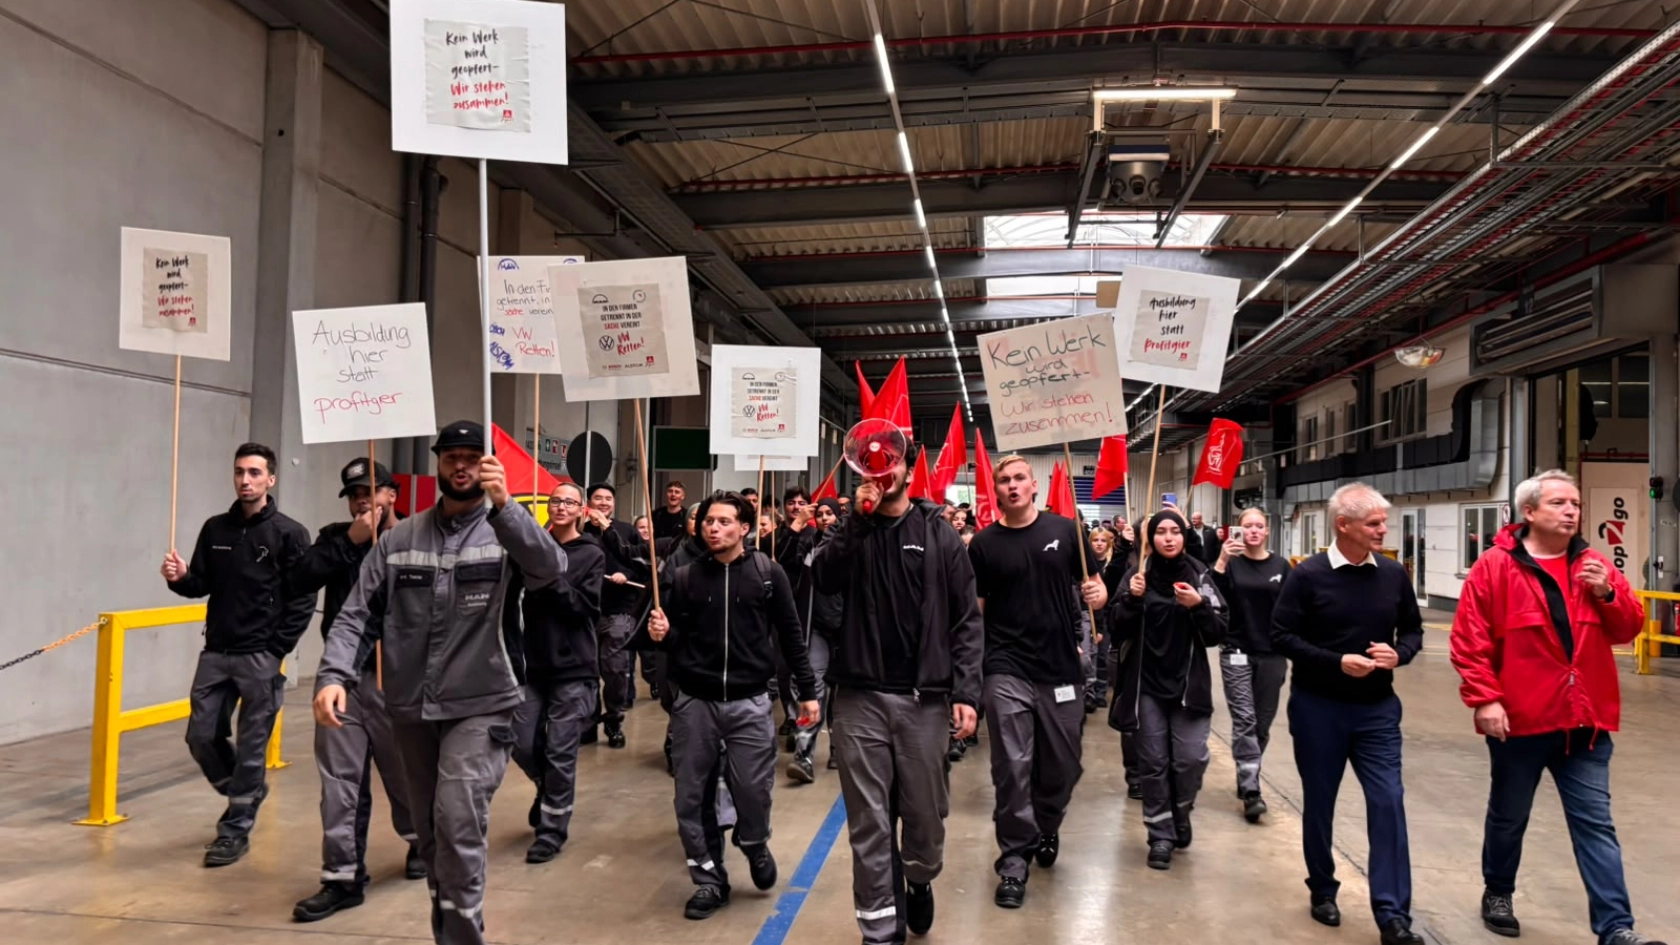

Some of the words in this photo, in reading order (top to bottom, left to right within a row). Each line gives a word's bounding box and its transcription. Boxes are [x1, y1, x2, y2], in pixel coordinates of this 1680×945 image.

[445, 31, 468, 46] Kein
[472, 28, 500, 44] Werk
[464, 45, 488, 59] wird
[450, 81, 470, 96] Wir
[473, 80, 506, 94] stehen
[453, 93, 509, 110] zusammen!
[167, 268, 182, 279] wird
[504, 279, 515, 295] In
[517, 282, 536, 295] den
[619, 303, 638, 311] FIRMEN
[1149, 295, 1196, 311] Ausbildung
[600, 313, 625, 321] GETRENNT
[1159, 310, 1178, 322] hier
[512, 326, 533, 340] VW
[604, 322, 620, 330] SACHE
[620, 321, 640, 329] VEREINT
[1160, 324, 1184, 336] statt
[349, 345, 388, 363] hier
[515, 340, 555, 358] Retten!
[617, 336, 645, 356] Retten!
[987, 342, 1042, 369] Kein
[1045, 324, 1107, 355] Werk
[1025, 358, 1067, 374] wird
[1000, 401, 1033, 418] Wir
[1041, 392, 1094, 409] stehen
